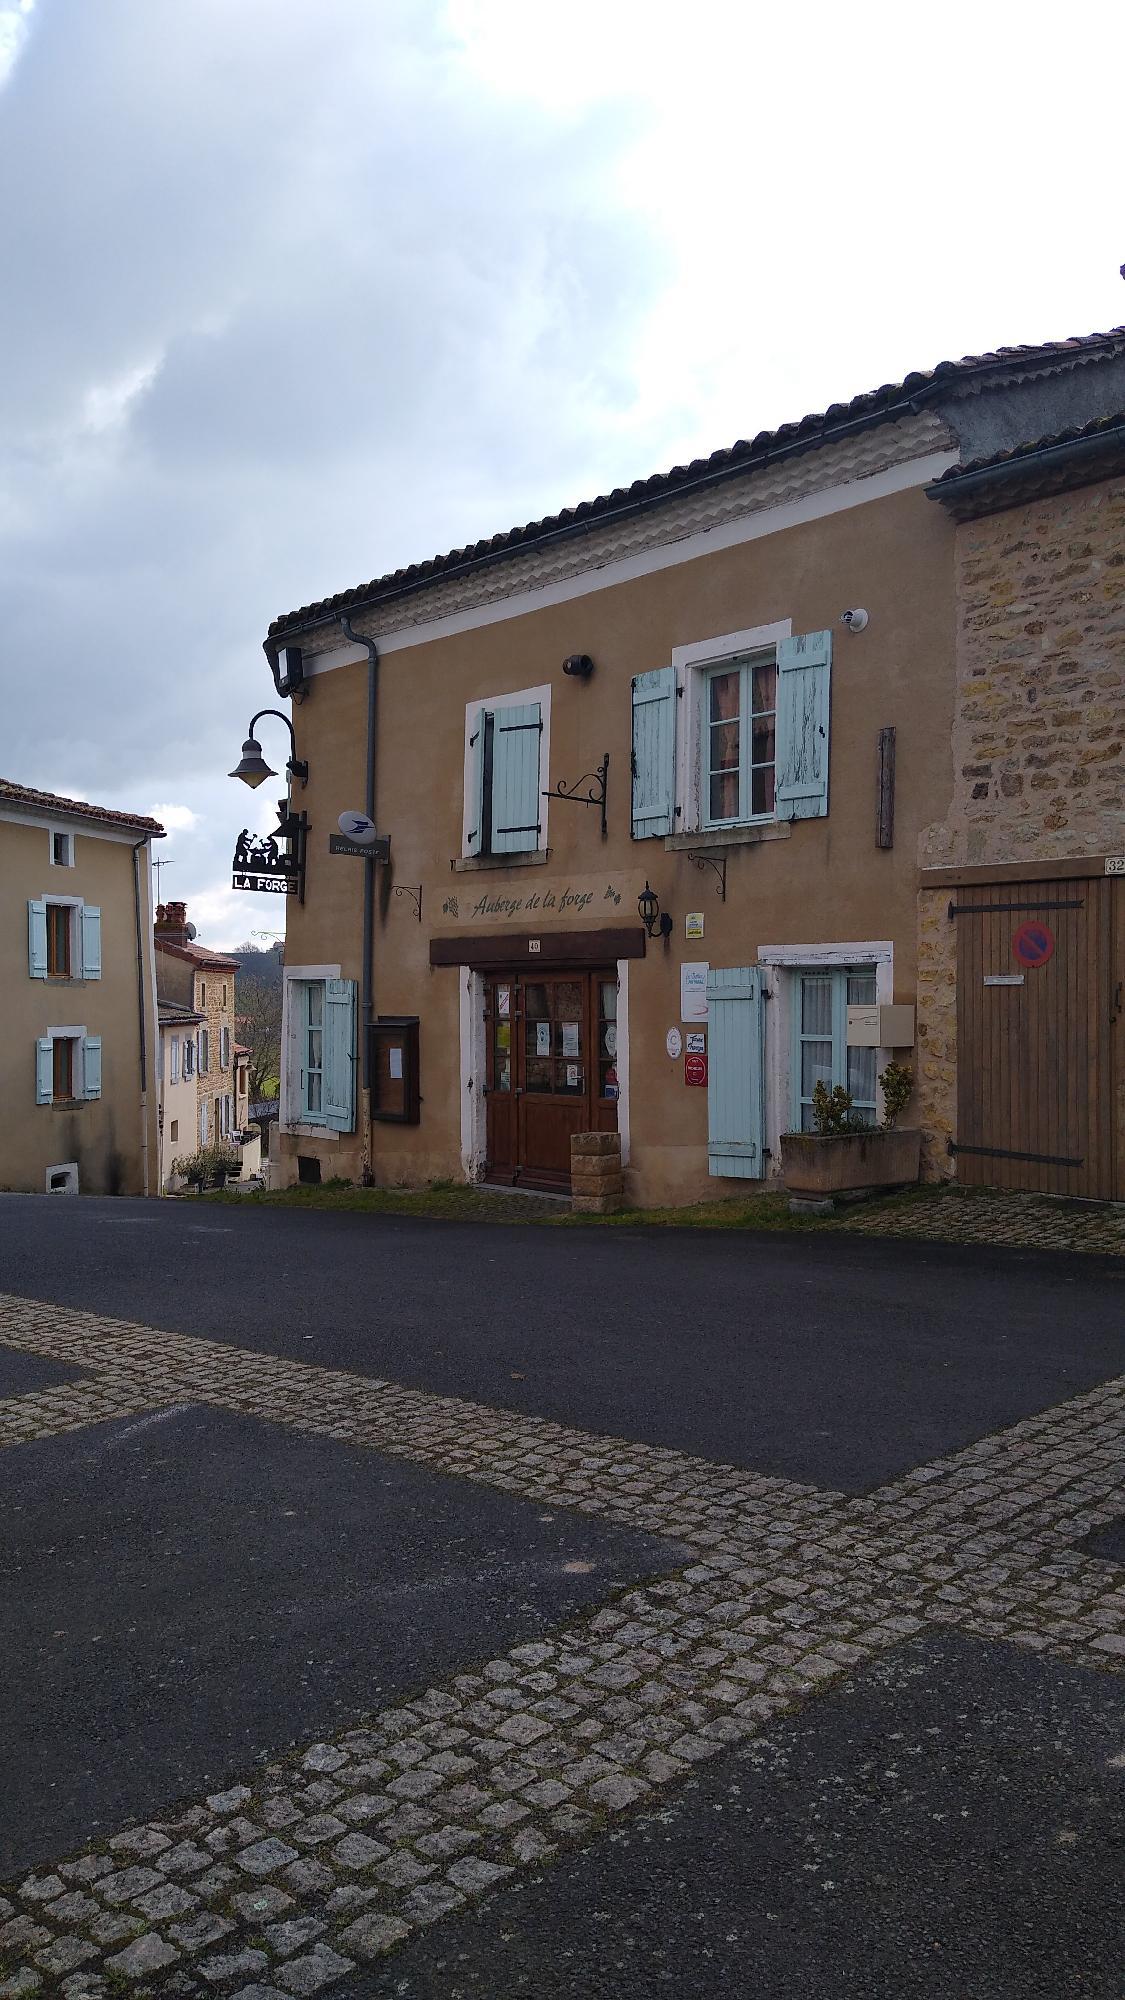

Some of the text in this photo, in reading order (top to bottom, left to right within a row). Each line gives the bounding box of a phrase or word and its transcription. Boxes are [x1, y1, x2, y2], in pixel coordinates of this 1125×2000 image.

[1108, 859, 1125, 871] 32
[234, 876, 296, 893] LA FORGE
[471, 886, 594, 918] Auberge de la forge
